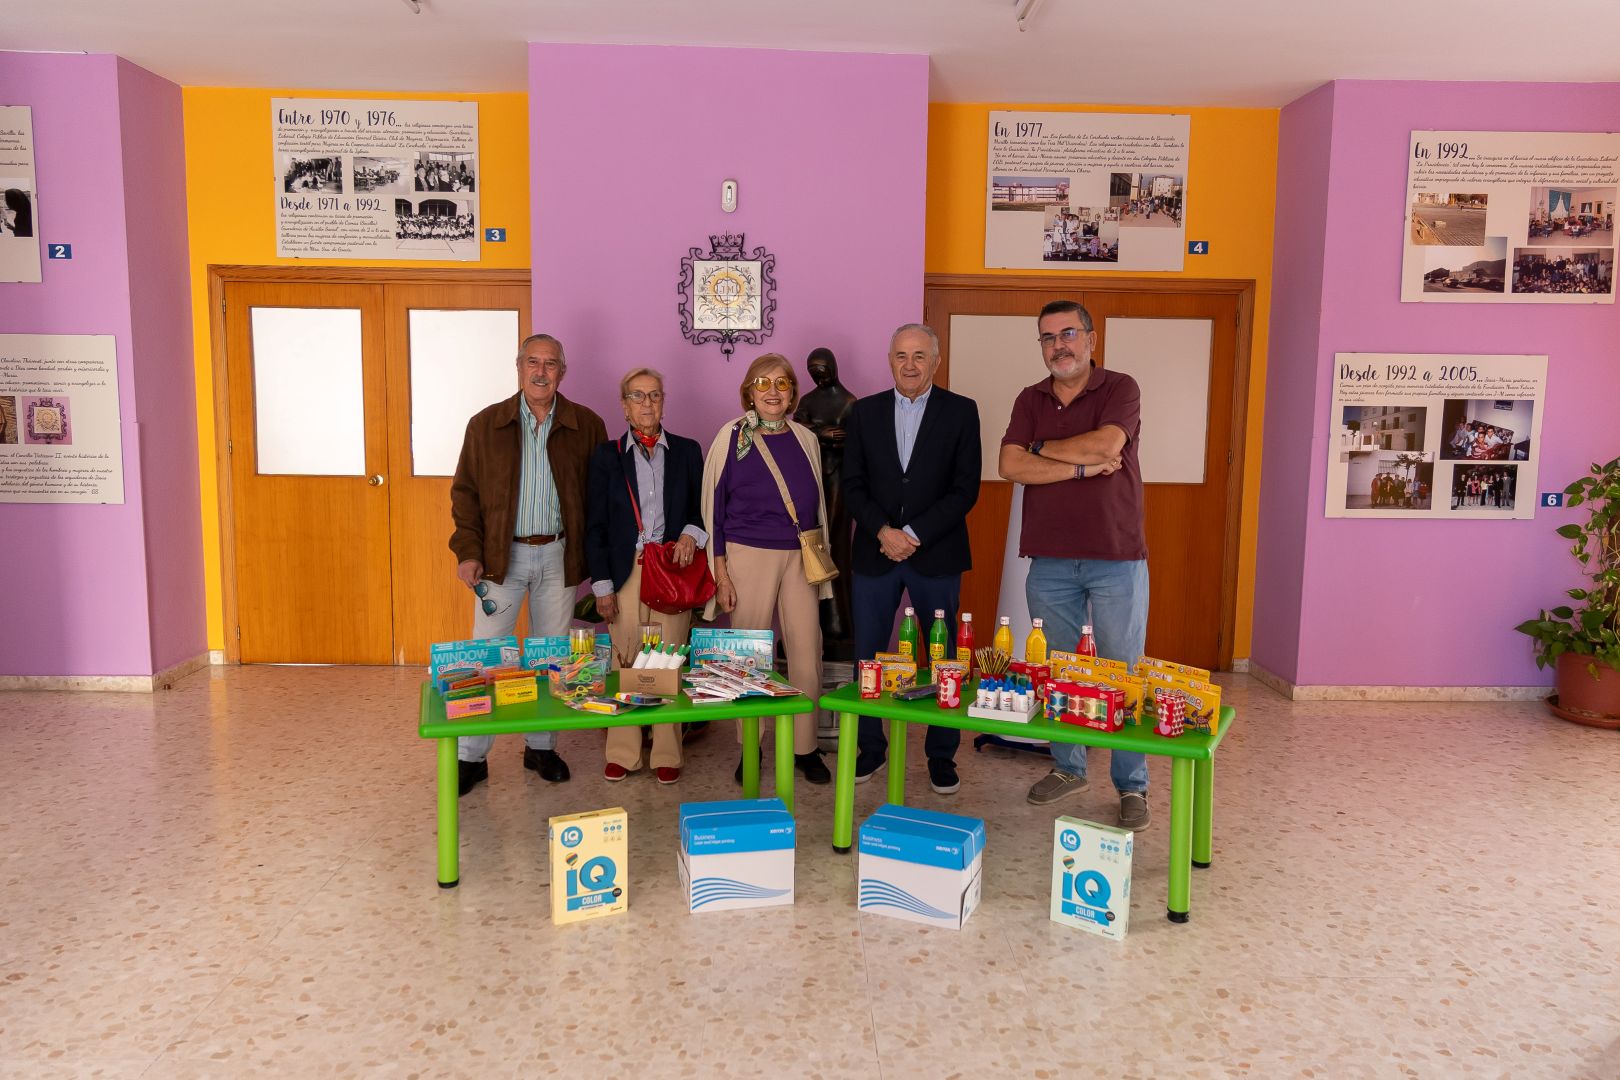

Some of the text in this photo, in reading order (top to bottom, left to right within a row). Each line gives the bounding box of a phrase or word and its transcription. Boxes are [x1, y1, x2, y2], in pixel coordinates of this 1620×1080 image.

[279, 109, 314, 125] Entre
[320, 110, 350, 125] 1970
[355, 118, 361, 129] y
[995, 121, 1010, 137] En
[1415, 142, 1431, 159] En
[281, 197, 312, 210] Desde
[319, 197, 338, 210] 1971
[344, 202, 351, 211] a
[491, 229, 500, 241] 3
[55, 246, 65, 257] 2
[1194, 242, 1203, 253] 4
[1340, 364, 1380, 381] Desde
[1386, 365, 1416, 380] 1992
[1423, 371, 1432, 381] a
[1547, 494, 1556, 506] 6
[432, 649, 488, 664] WINDOW
[525, 646, 571, 657] WINDO
[564, 831, 579, 841] IQ
[1063, 833, 1077, 844] IQ
[582, 894, 602, 905] COLOR
[1075, 906, 1095, 918] COLOR
